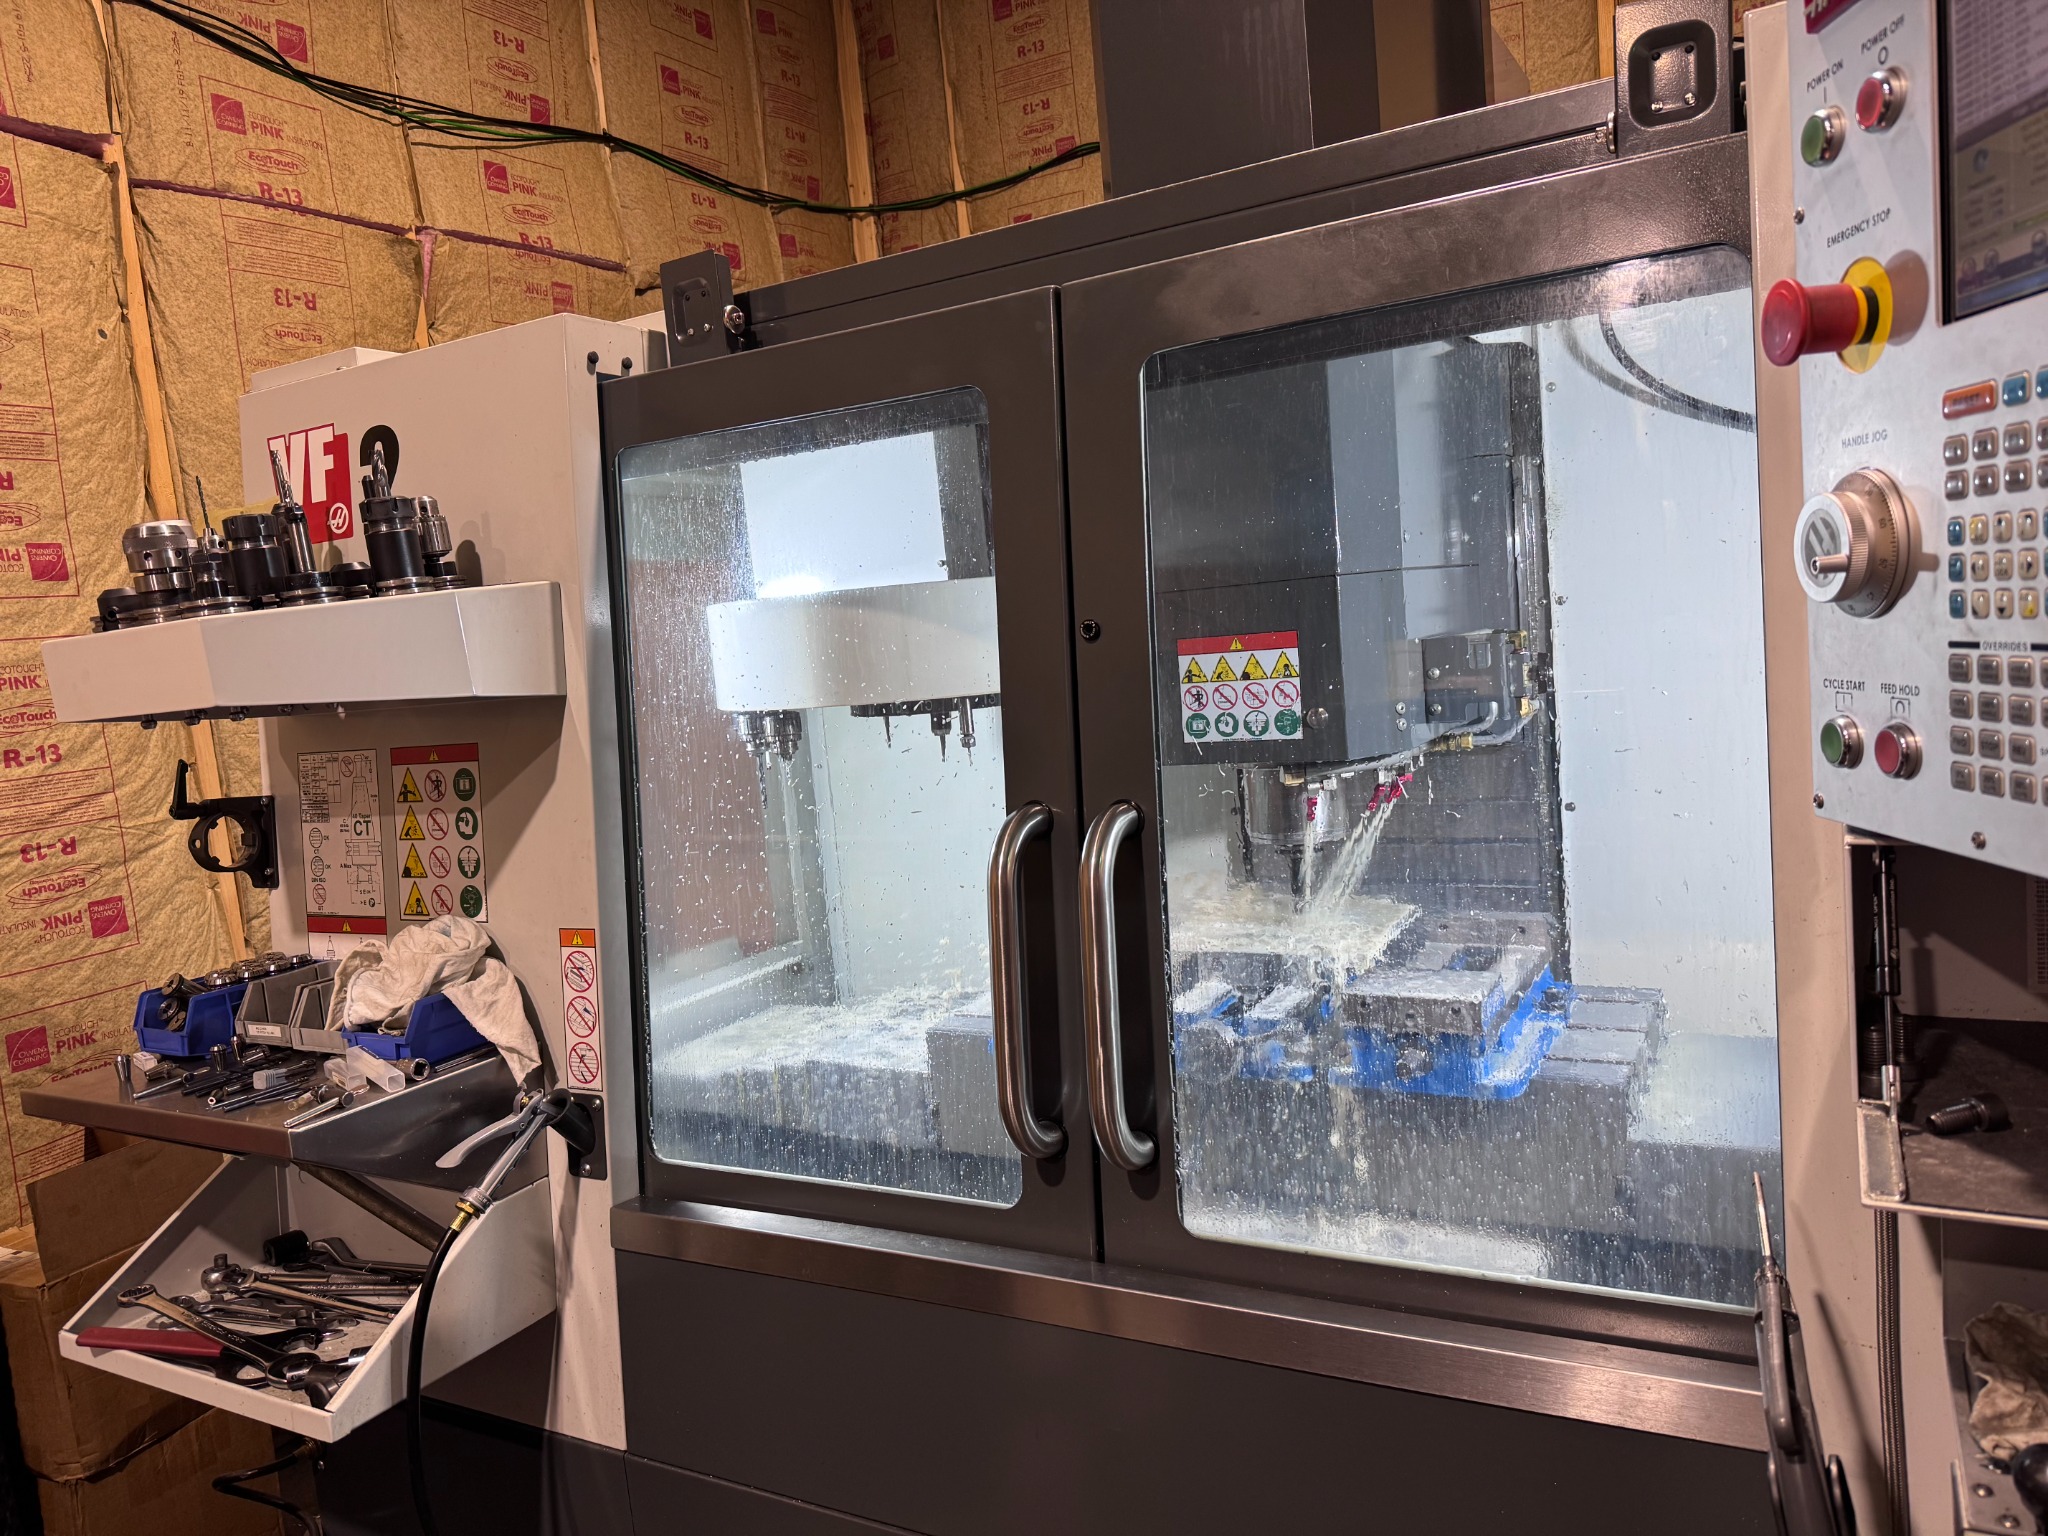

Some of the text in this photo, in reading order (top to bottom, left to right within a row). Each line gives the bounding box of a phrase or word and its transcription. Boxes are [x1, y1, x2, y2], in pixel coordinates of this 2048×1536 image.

[238, 11, 271, 34] PINK
[1013, 18, 1045, 33] EcoTouch
[493, 29, 525, 54] R-13
[1861, 14, 1905, 54] POWER OFF
[1017, 39, 1045, 58] R-13
[494, 60, 529, 81] EcoTouch
[781, 69, 800, 87] R-13
[1806, 59, 1844, 93] POWER ON
[504, 88, 527, 106] PINK
[683, 85, 701, 101] PINK
[1022, 97, 1051, 116] R-13
[250, 120, 285, 141] PINK
[785, 126, 806, 144] R-13
[1023, 123, 1055, 137] EcoTouch
[684, 131, 709, 150] R-13
[1032, 144, 1053, 157] PINK
[248, 151, 299, 170] EcoTouch
[258, 181, 304, 206] R-13
[512, 181, 537, 198] PINK
[691, 192, 717, 209] R-13
[512, 206, 549, 222] EcoTouch
[1826, 207, 1891, 248] EMERGENCY STOP
[519, 231, 554, 250] R-13
[524, 280, 549, 298] PINK
[273, 287, 318, 312] R-13
[275, 329, 323, 345] EcoTouch
[1842, 429, 1888, 449] HANDLE JOG
[28, 547, 61, 556] CORNING
[31, 554, 58, 562] OWENS
[1982, 640, 2028, 652] OVERRIDES
[1823, 678, 1866, 692] CYCLE START
[1880, 682, 1921, 697] FEED HOLD
[3, 743, 62, 769] R-13
[359, 812, 371, 820] Taper
[353, 820, 372, 837] CT
[20, 836, 77, 863] R-13
[22, 877, 87, 899] EcoTouch
[90, 901, 122, 913] CORNING
[92, 908, 117, 920] OWENS
[41, 910, 83, 932] PINK
[56, 1030, 98, 1054] PINK
[13, 1052, 49, 1067] CORNING
[18, 1045, 48, 1059] OWENS
